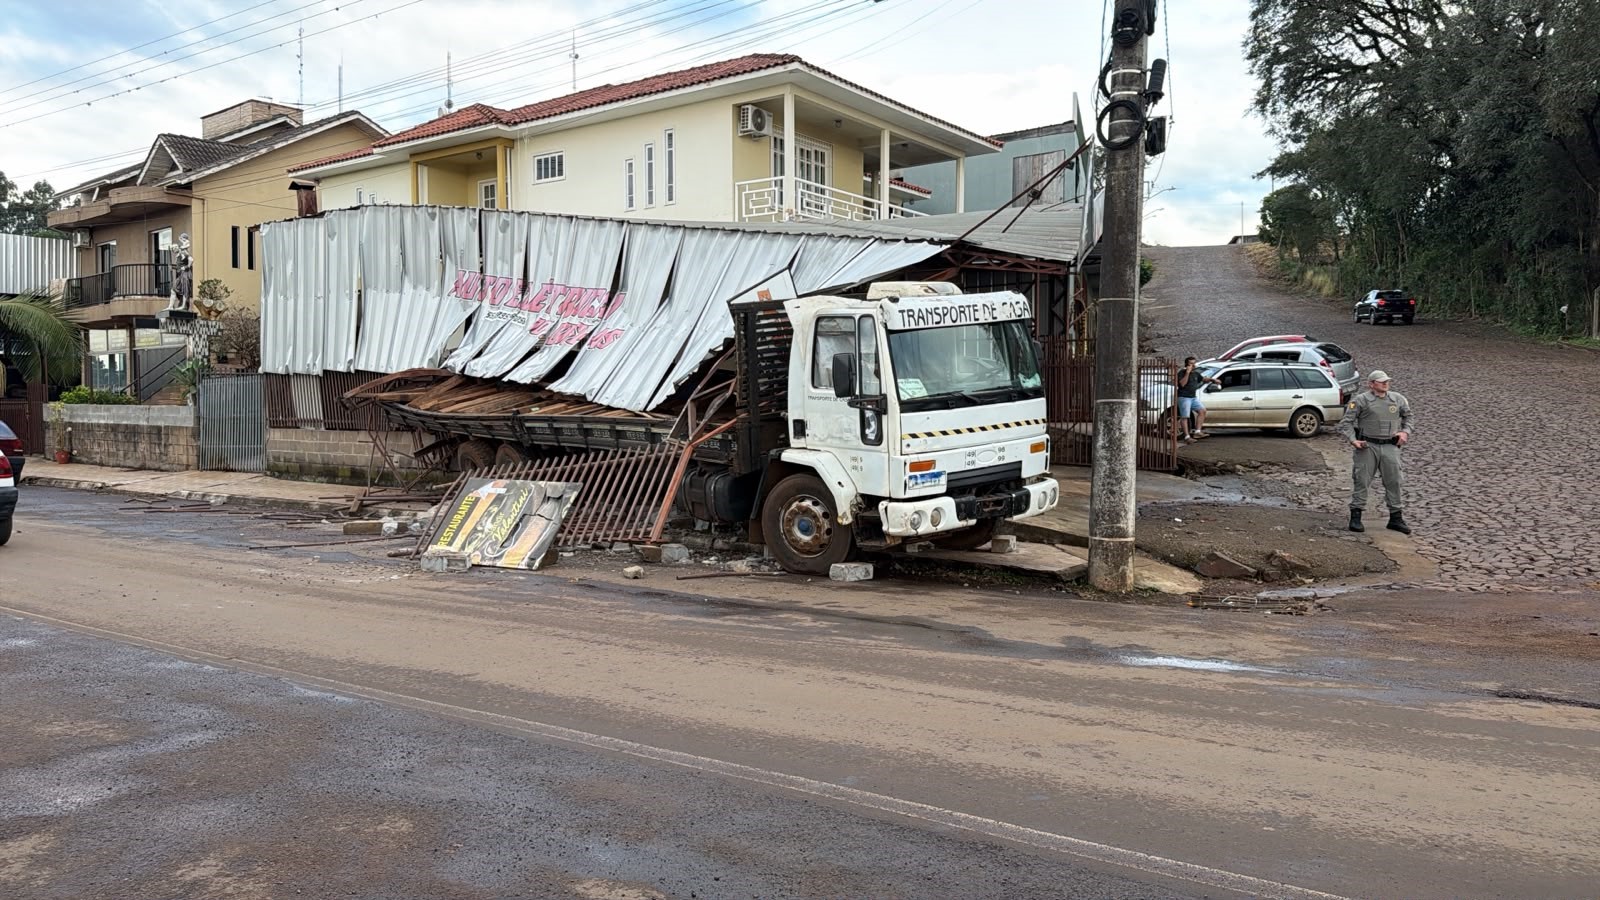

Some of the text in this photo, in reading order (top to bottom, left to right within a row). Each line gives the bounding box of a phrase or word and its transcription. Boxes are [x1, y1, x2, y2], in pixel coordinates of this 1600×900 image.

[447, 269, 513, 306] AUTO
[898, 303, 980, 328] TRANSPORTE
[982, 303, 998, 320] DE
[437, 494, 476, 547] RESTAURANTE
[491, 486, 530, 543] Valentini
